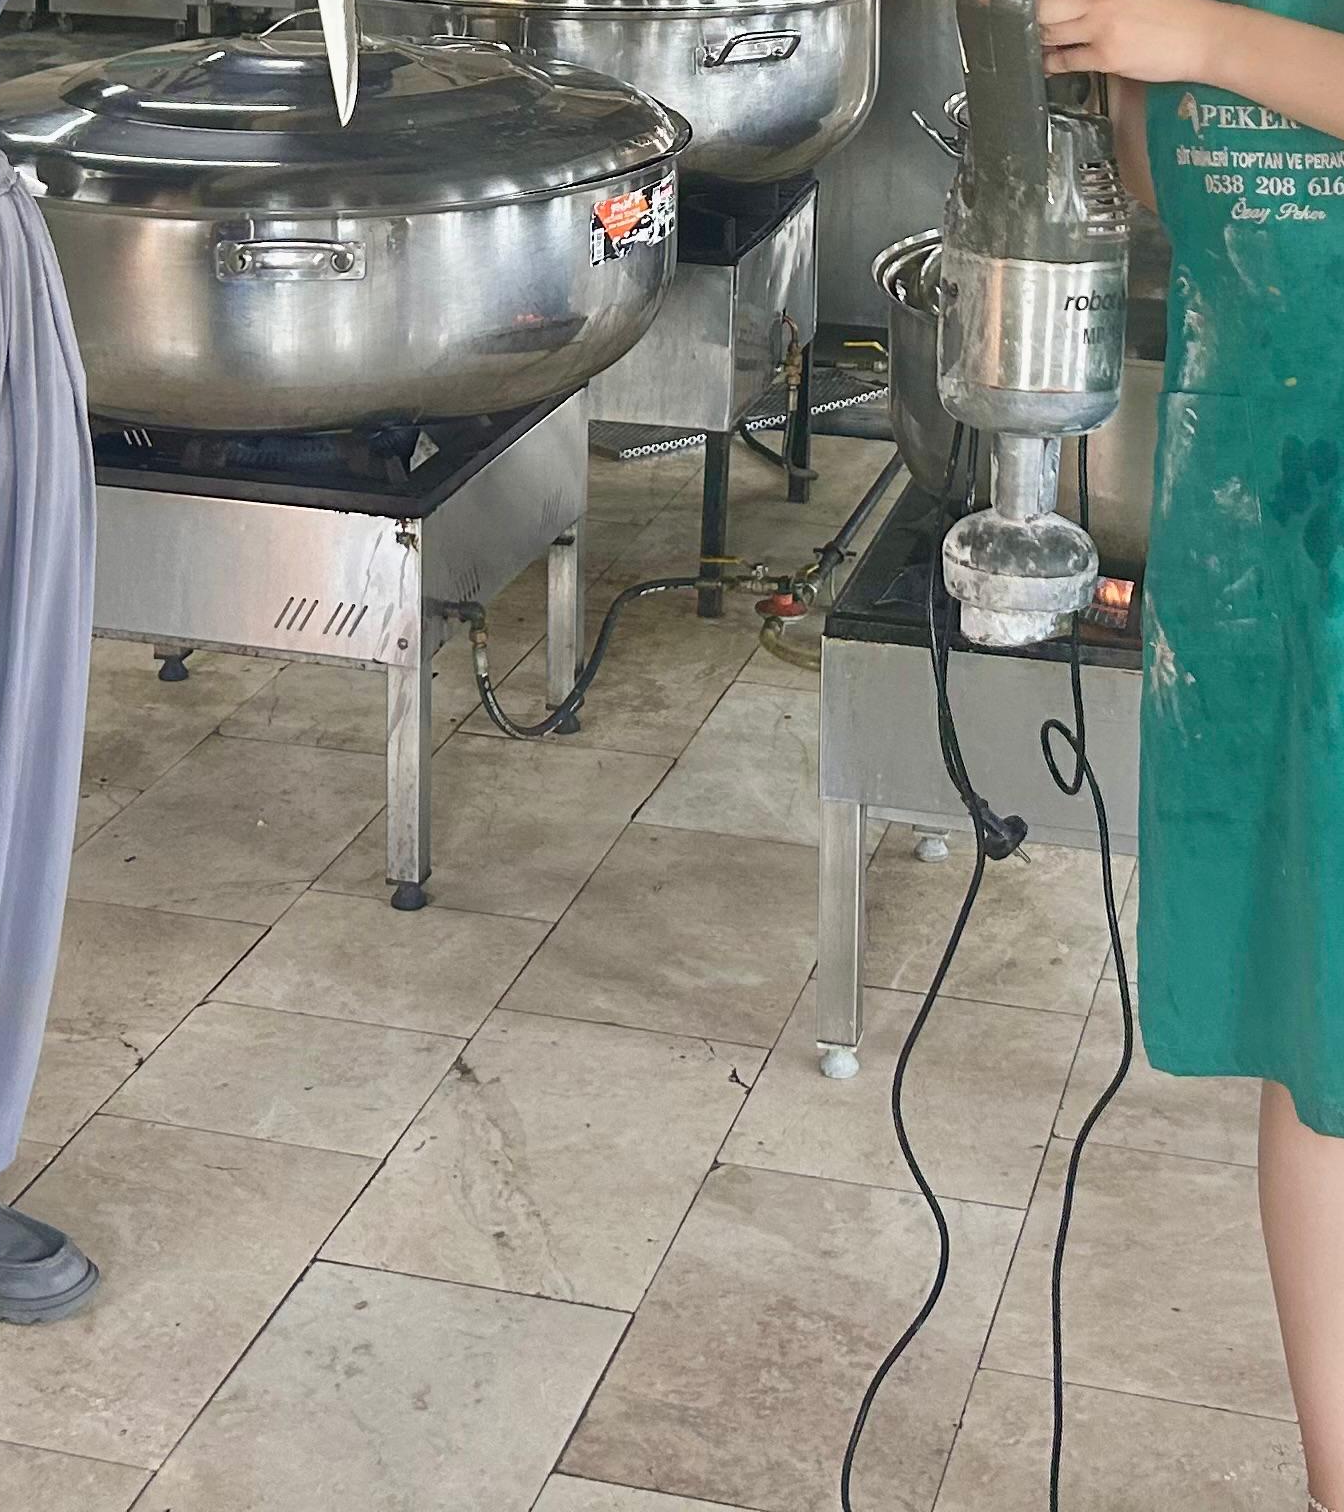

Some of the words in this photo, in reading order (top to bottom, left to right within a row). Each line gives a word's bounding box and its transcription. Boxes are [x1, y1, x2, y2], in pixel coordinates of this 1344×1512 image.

[1230, 151, 1283, 169] TOPTAN
[1285, 152, 1303, 169] VE
[1205, 174, 1244, 194] 0538
[1255, 176, 1296, 196] 208
[1275, 202, 1327, 220] Peker
